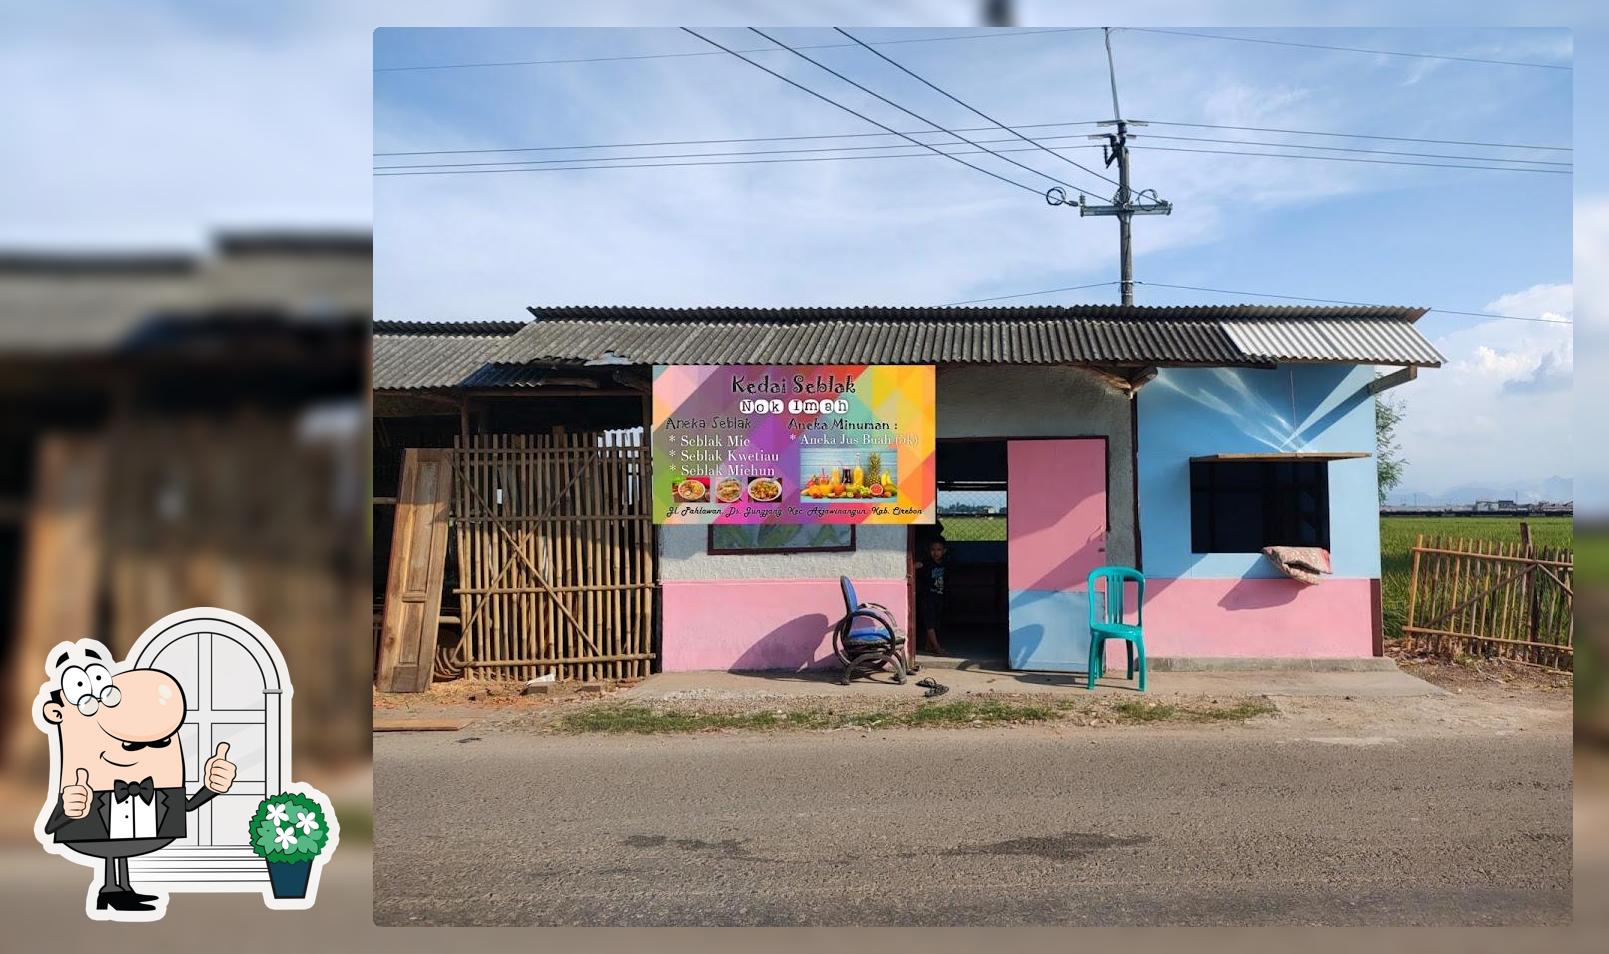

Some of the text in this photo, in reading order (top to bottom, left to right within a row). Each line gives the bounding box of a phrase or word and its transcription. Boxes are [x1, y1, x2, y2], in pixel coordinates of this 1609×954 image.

[732, 375, 856, 393] Kedai Seblak
[740, 399, 784, 414] Nok
[665, 416, 751, 430] Aneka Seblak
[788, 418, 828, 431] Aneka
[831, 418, 890, 431] Minuman
[680, 434, 750, 447] Seblak Mie
[800, 434, 836, 446] Aneka
[840, 434, 859, 446] Jus
[863, 434, 891, 446] Buah
[681, 449, 779, 462] Seblak Kwetiau
[681, 464, 722, 477] Seblak
